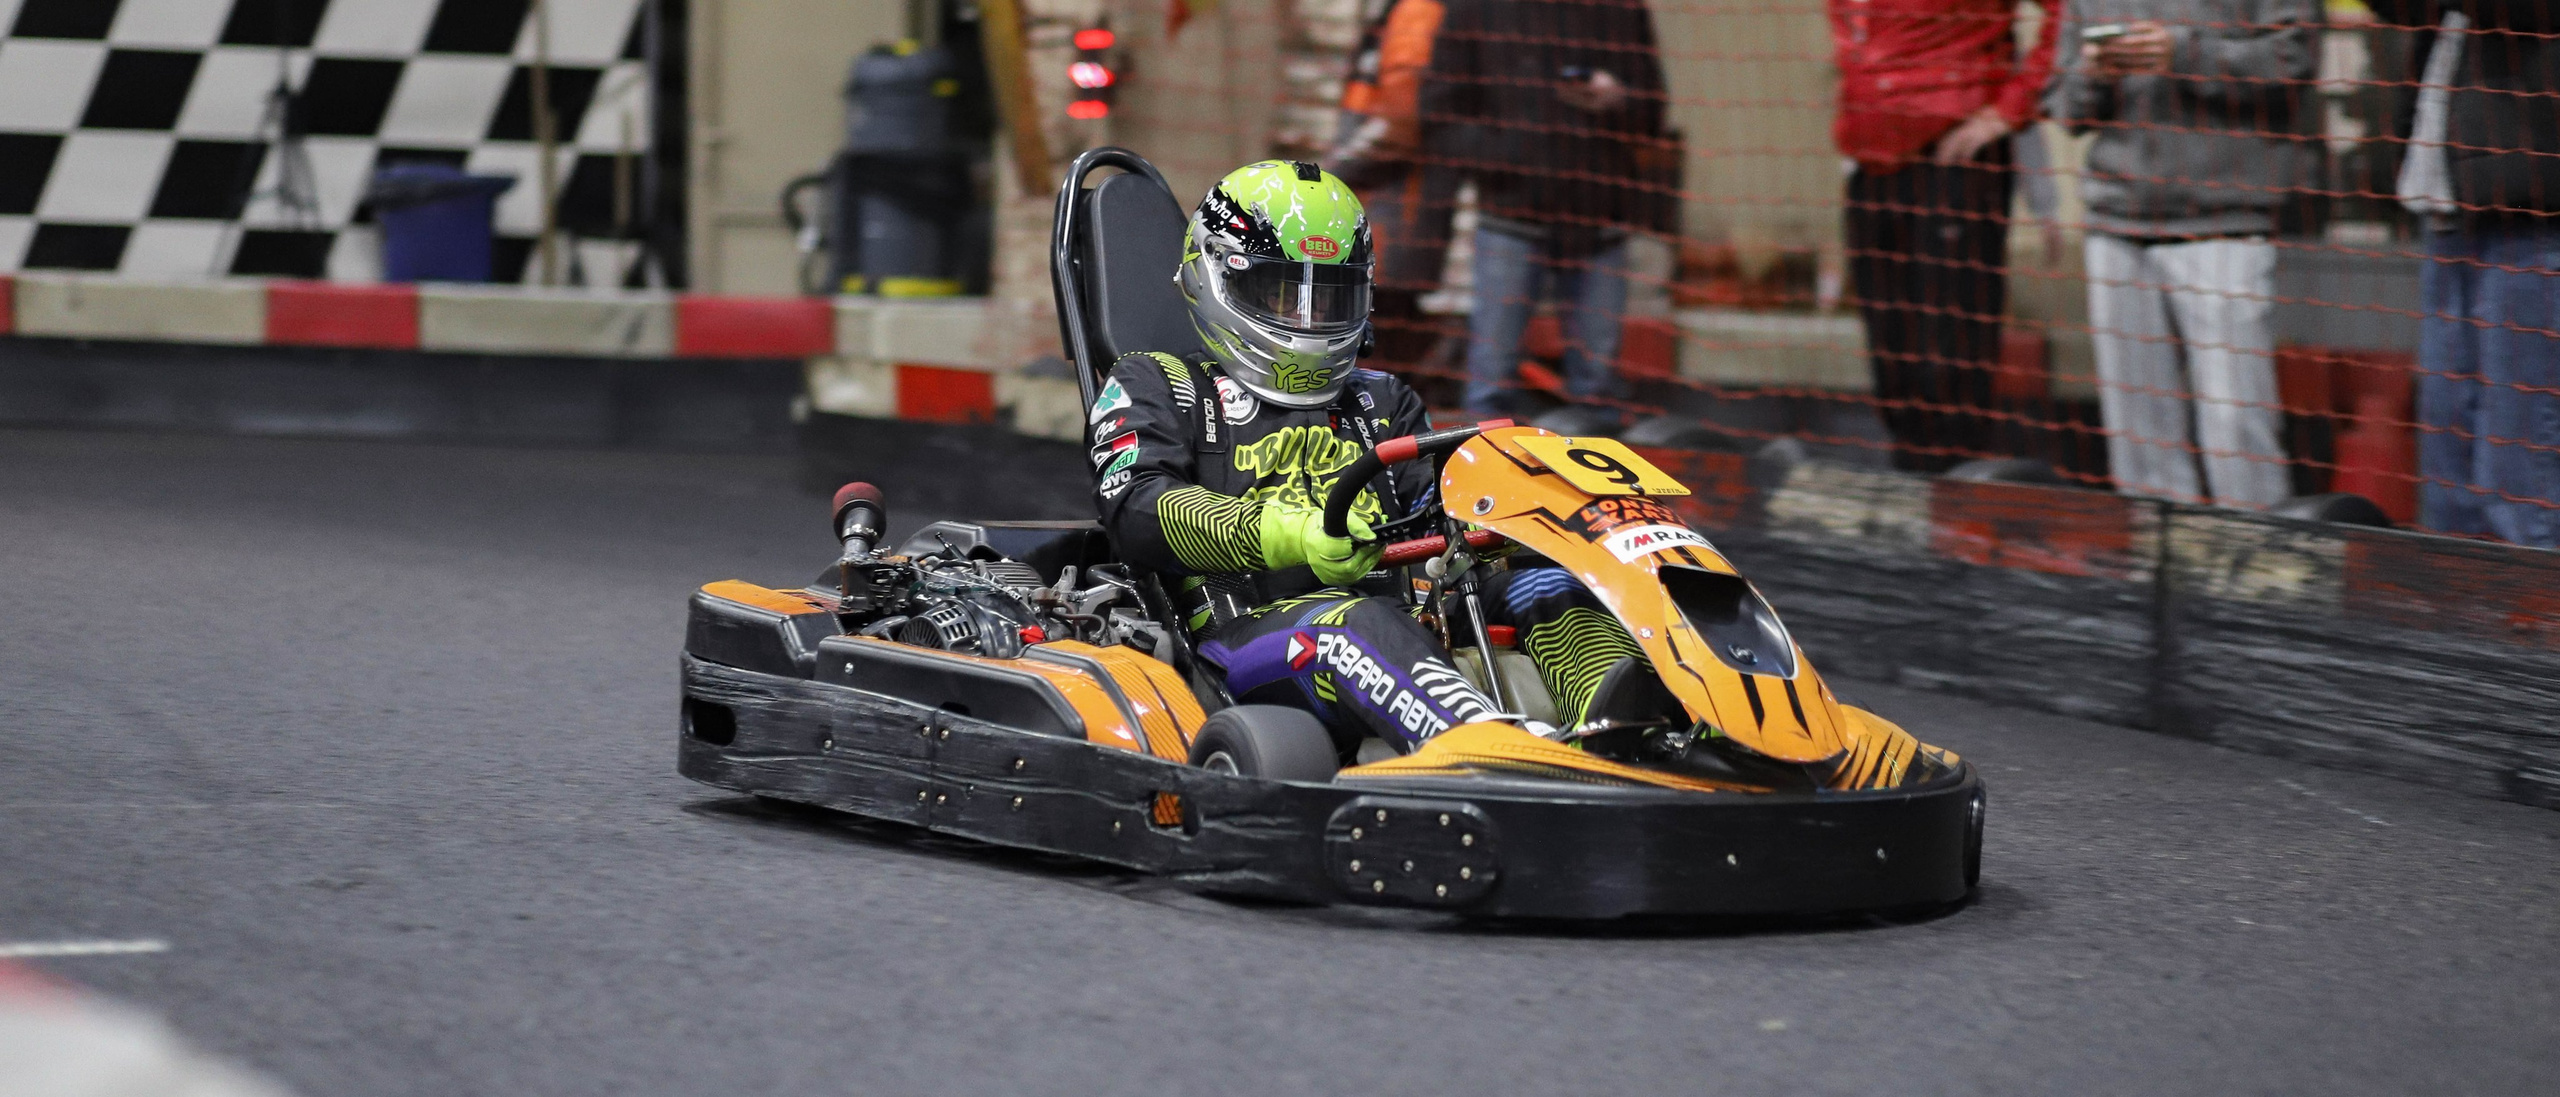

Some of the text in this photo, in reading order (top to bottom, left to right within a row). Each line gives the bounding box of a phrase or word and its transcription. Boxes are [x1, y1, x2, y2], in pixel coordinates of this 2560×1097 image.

[1305, 240, 1335, 253] BELL
[1230, 257, 1246, 267] BELL
[1271, 362, 1332, 394] YES
[1203, 397, 1217, 443] BENGIO
[1101, 469, 1132, 490] OYO
[1567, 449, 1640, 485] 9
